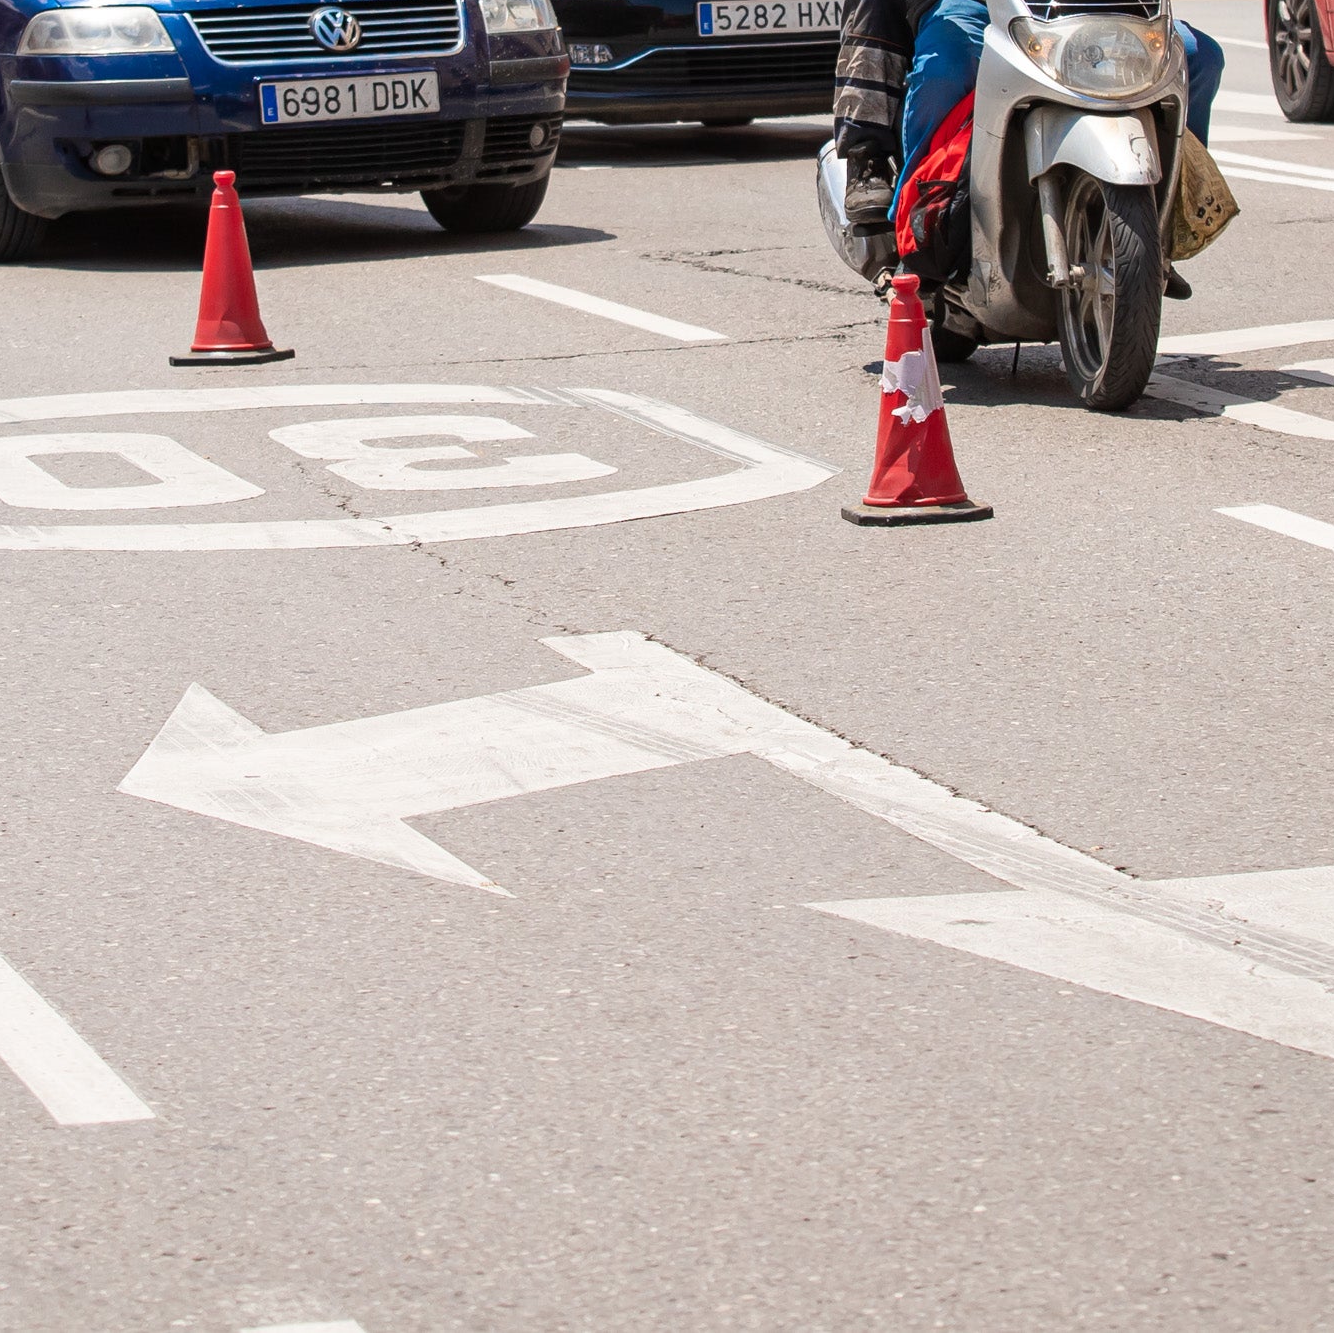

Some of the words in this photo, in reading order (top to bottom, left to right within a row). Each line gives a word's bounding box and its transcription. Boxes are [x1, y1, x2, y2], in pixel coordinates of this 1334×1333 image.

[717, 3, 788, 30] 5282
[283, 83, 358, 116] 6981
[373, 77, 429, 111] DDK
